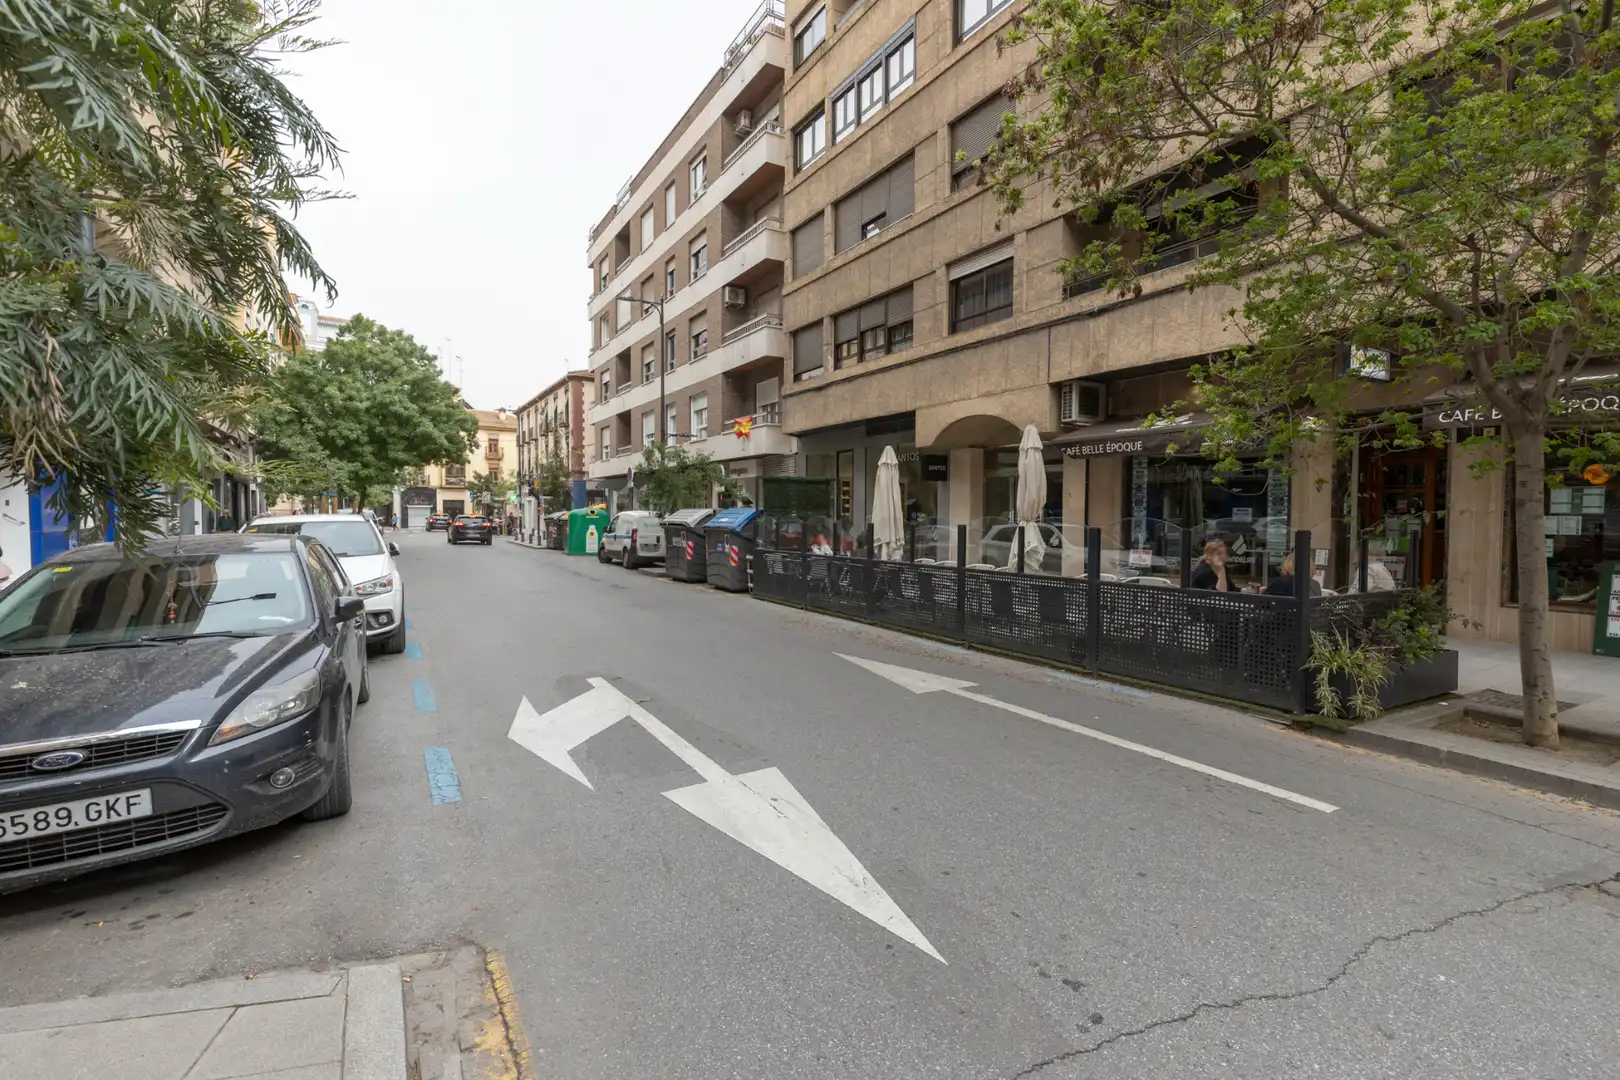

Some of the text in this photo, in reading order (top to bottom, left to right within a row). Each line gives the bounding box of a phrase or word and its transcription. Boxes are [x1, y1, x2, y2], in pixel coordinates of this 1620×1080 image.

[1082, 444, 1105, 455] BELLE
[1106, 440, 1143, 453] ÉPOQUE
[897, 451, 921, 463] ANTOS
[43, 755, 72, 767] Ford
[84, 793, 142, 823] GKF
